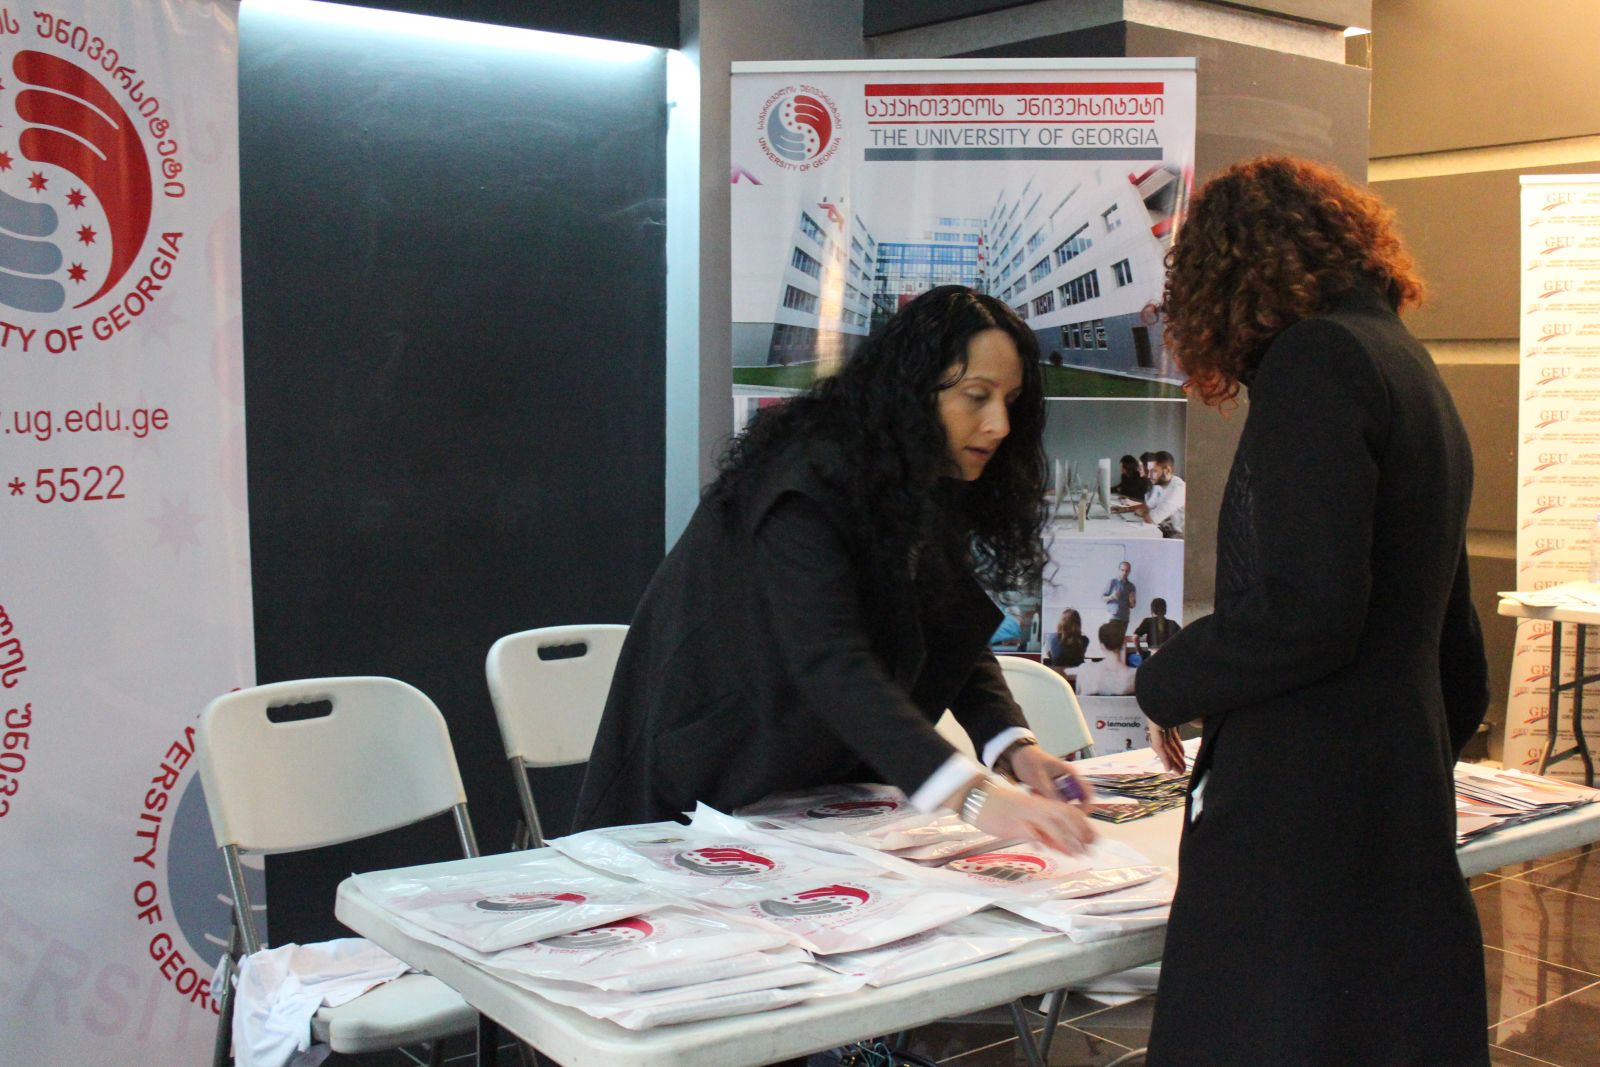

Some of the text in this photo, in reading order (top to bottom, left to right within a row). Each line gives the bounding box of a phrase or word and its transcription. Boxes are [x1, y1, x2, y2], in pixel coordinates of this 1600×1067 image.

[33, 11, 186, 198] უნივერსიტეტი
[864, 97, 1164, 118] საქართველოს უნივერსიტეტი
[870, 128, 1160, 146] THE UNIVERSITY OF GEORGIA
[44, 325, 84, 354] OF
[92, 232, 184, 342] GEORGIA
[1541, 367, 1571, 378] GEU
[0, 402, 169, 442] .ug.edu.ge
[1539, 410, 1569, 421] GEU
[1538, 453, 1568, 464] GEU
[1536, 496, 1567, 507] GEU
[1535, 539, 1565, 550] GEU
[133, 880, 163, 926] OF
